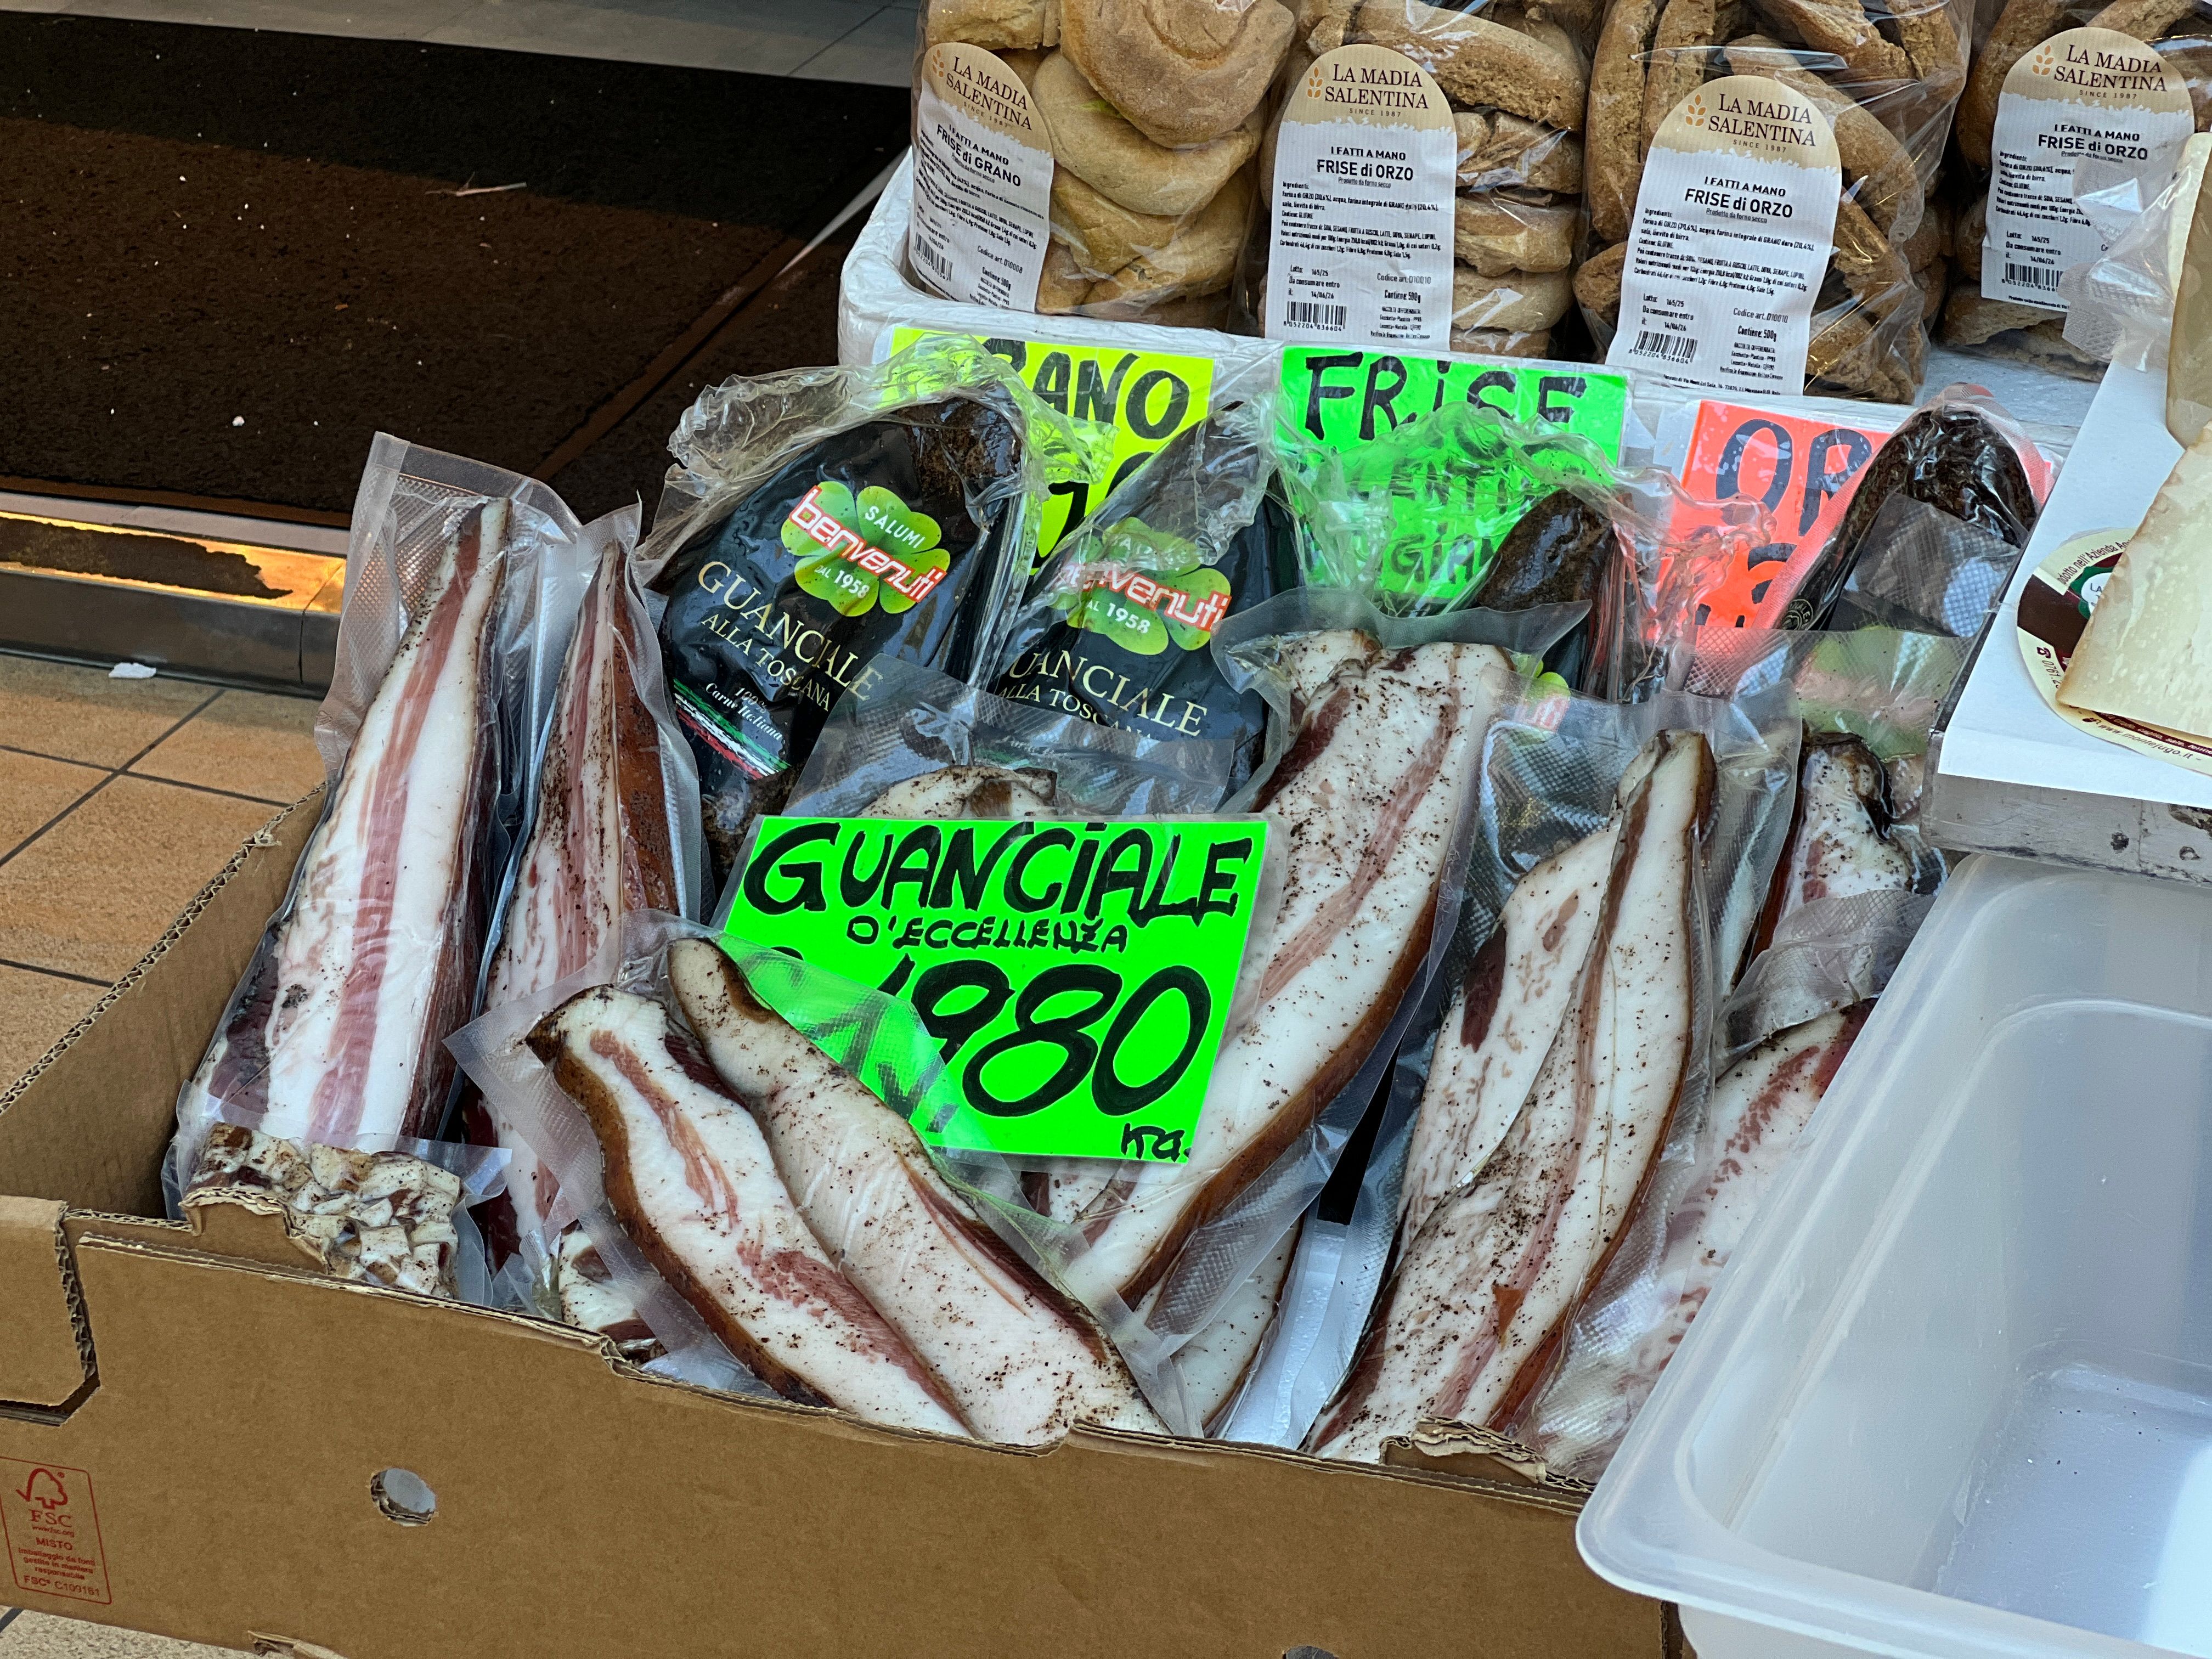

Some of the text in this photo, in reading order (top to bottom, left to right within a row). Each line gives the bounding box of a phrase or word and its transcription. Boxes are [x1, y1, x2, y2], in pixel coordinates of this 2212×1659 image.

[2066, 44, 2161, 72] LA MADIA
[953, 56, 1027, 111] LA MADIA
[1333, 64, 1423, 87] LA MADIA
[2054, 66, 2167, 92] SALENTINA
[946, 73, 1032, 131] SALENTINA
[1325, 87, 1429, 109] SALENTINA
[2079, 89, 2107, 98] SINCE
[964, 101, 1008, 127] SINCE 1987
[1718, 93, 1812, 123] LA MADIA
[1708, 116, 1816, 146] SALENTINA
[2061, 125, 2091, 135] FATTI
[2105, 131, 2140, 141] MANO
[937, 124, 961, 156] FRISE
[962, 151, 971, 164] di
[975, 157, 1020, 187] GRANO
[981, 147, 1009, 165] MANO
[1337, 147, 1363, 157] FATTI
[1366, 150, 1373, 158] A
[1375, 150, 1406, 161] MANO
[1733, 139, 1786, 153] SINCE 1987
[2039, 134, 2084, 149] FRISE
[2089, 141, 2101, 151] di
[2105, 144, 2147, 160] ORZO
[1317, 159, 1413, 180] FRISE di ORZO
[1338, 177, 1357, 185] Prodotto
[1705, 176, 1786, 197] I FATTI A MANO
[1685, 188, 1793, 218] FRISE di ORZO
[1706, 207, 1728, 217] Prodotto
[1377, 273, 1431, 284] Codice 010010
[1643, 305, 1649, 313] Da
[1734, 308, 1754, 318] Codice
[1767, 313, 1788, 323] 010010
[1764, 329, 1776, 342] 500g
[1716, 419, 1872, 537] OR
[865, 506, 926, 549] SALUMI
[791, 486, 943, 602] benvenuti
[814, 566, 871, 599] DAL 1958
[1086, 600, 1150, 634] AL 1958
[698, 561, 884, 702] GUANCIALE
[702, 614, 831, 712] ALLA TOSCANA
[999, 684, 1040, 703] ALLA
[1009, 650, 1207, 737] UANCIALE
[29, 1509, 72, 1528] FSC
[36, 1537, 72, 1550] MISTO
